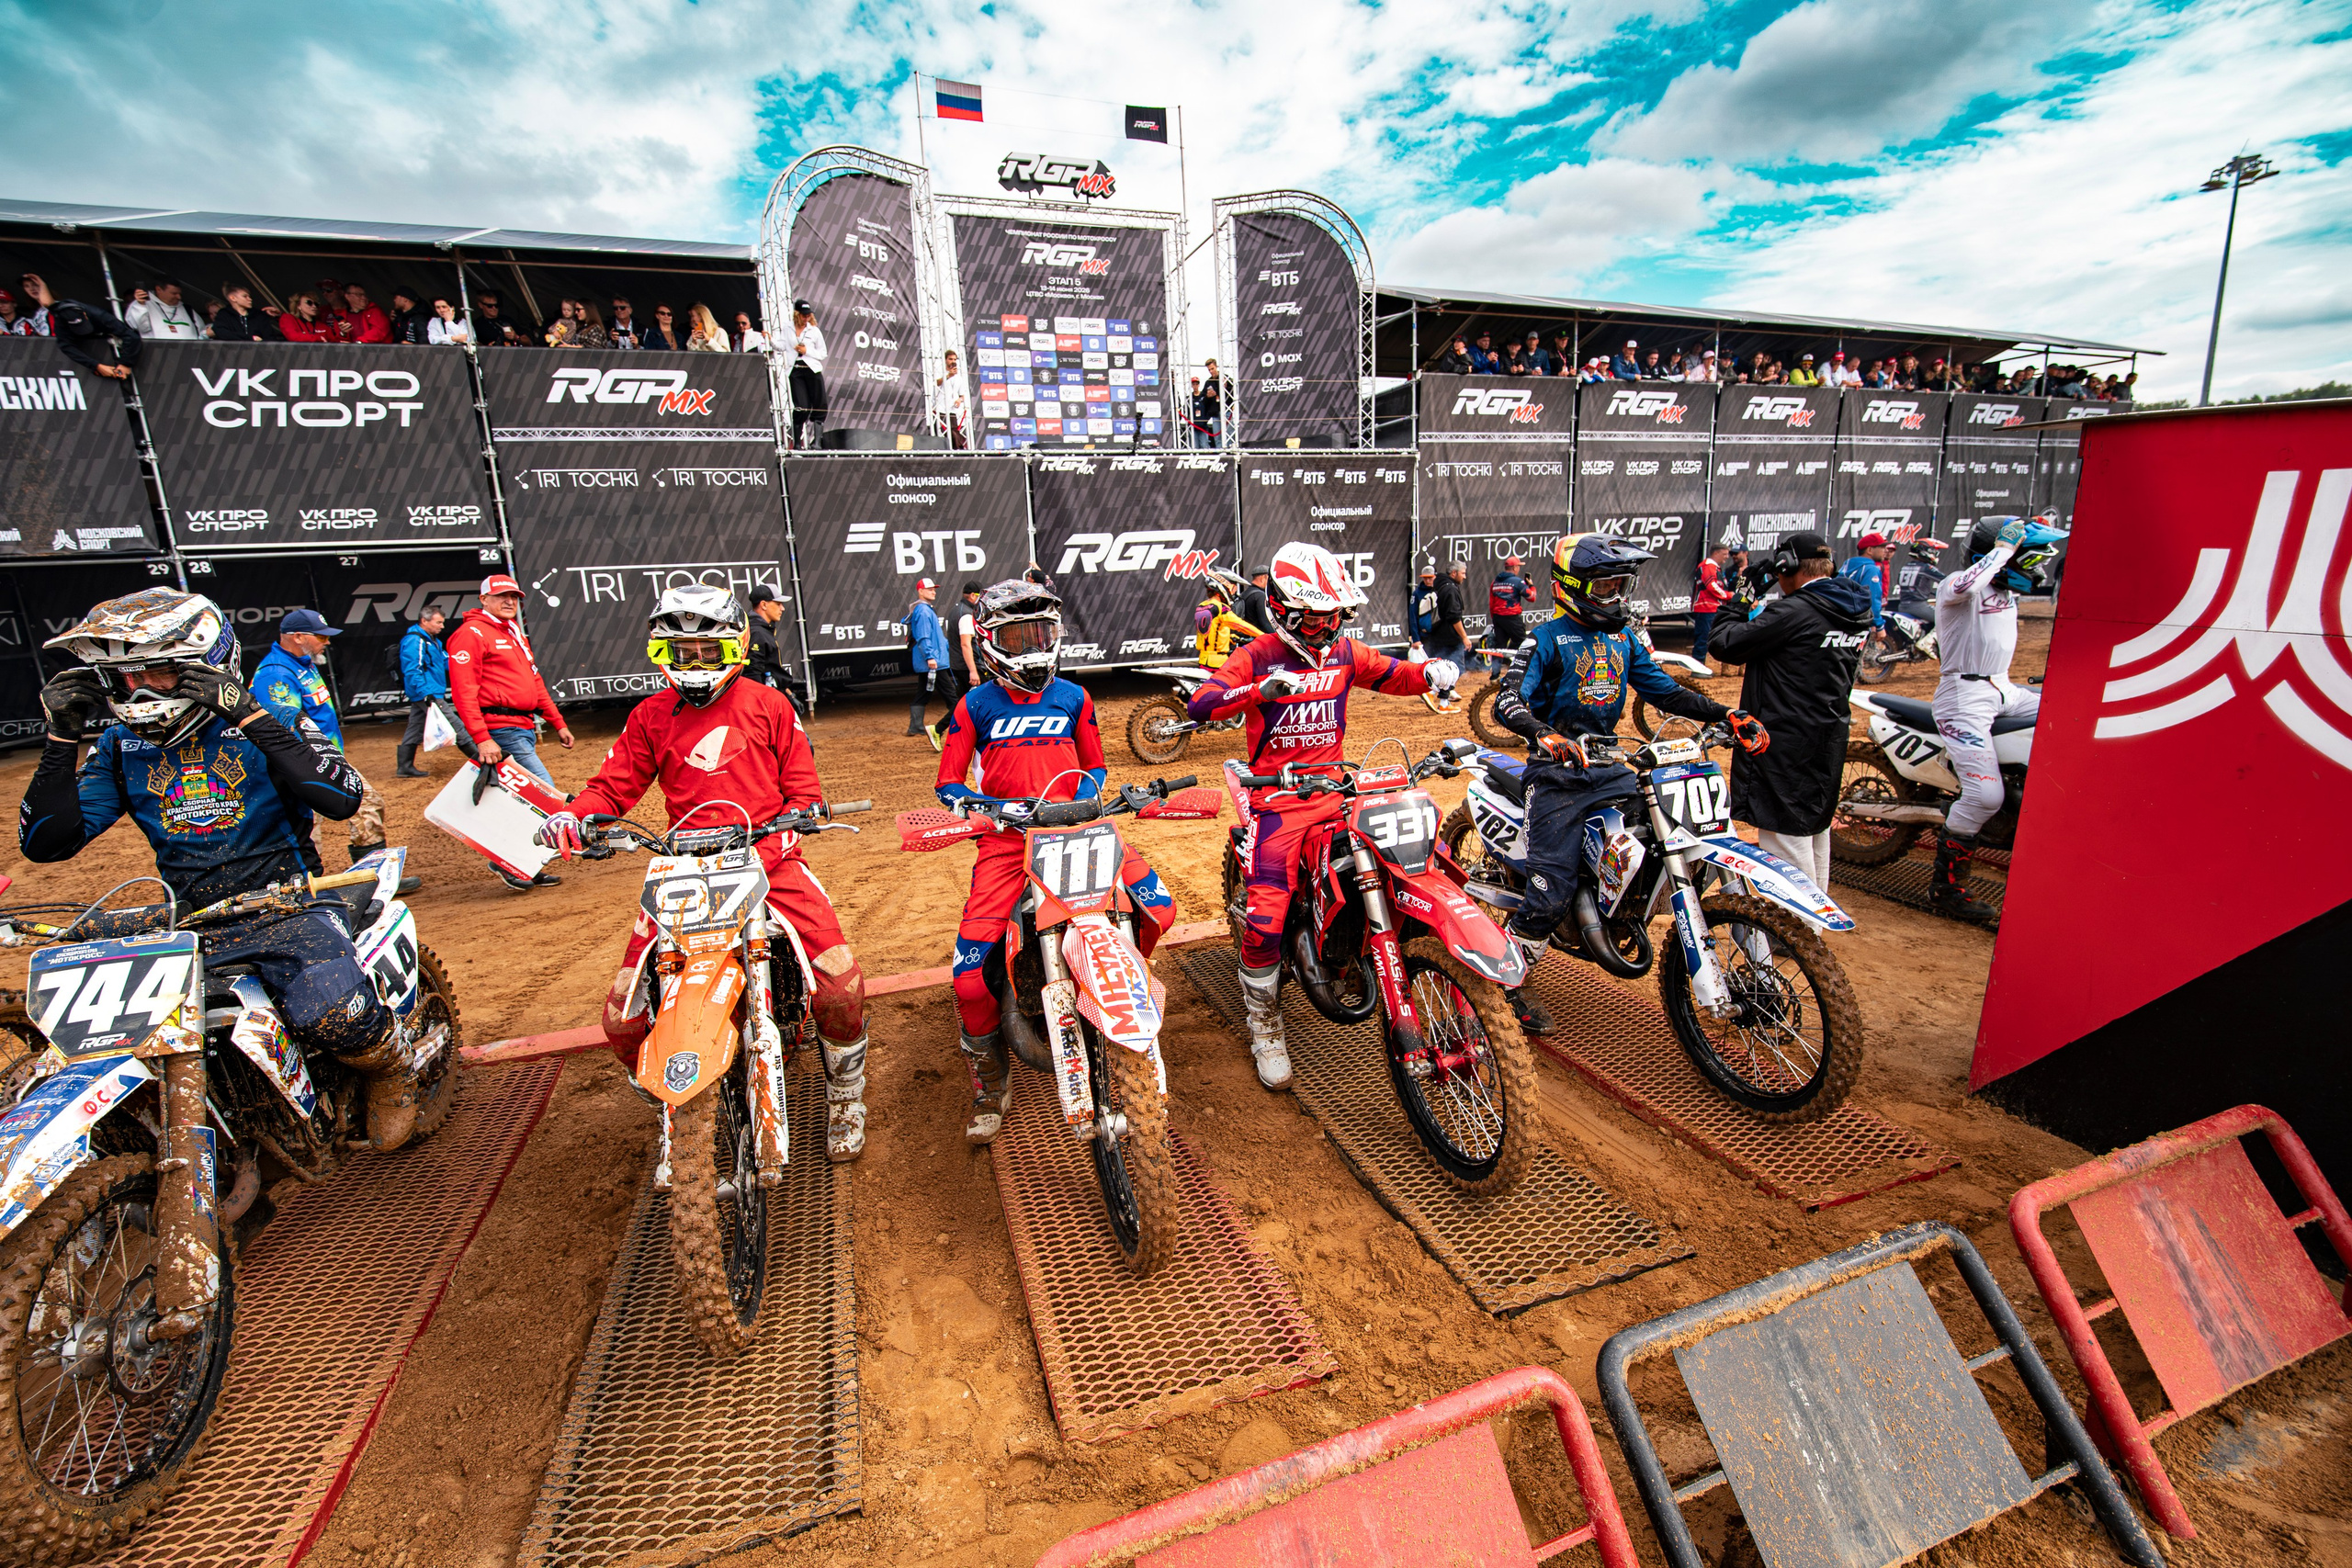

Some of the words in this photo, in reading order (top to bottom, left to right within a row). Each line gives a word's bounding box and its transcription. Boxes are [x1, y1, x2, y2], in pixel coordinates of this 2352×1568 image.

[859, 241, 888, 262] ВТБ
[1048, 276, 1073, 286] ЭТАП
[1075, 278, 1081, 287] 5
[1272, 270, 1299, 287] ВТБ
[858, 369, 900, 383] СПОРТ
[288, 369, 421, 398] ПРО
[1261, 384, 1303, 393] СПОРТ
[202, 400, 424, 428] СПОРТ
[1454, 464, 1492, 477] TOCHKI
[1527, 463, 1562, 476] TOCHKI
[1594, 460, 1614, 468] ПРО
[1639, 460, 1659, 468] ПРО
[1670, 467, 1702, 475] СПОРТ
[1951, 463, 1965, 474] ВТБ
[1973, 464, 1986, 474] ВТБ
[1995, 464, 2008, 474] ВТБ
[2016, 464, 2030, 474] ВТБ
[702, 470, 768, 486] TOCHKI
[1261, 471, 1284, 486] ВТБ
[1303, 471, 1326, 485] ВТБ
[1344, 470, 1367, 484] ВТБ
[1384, 469, 1407, 483] ВТБ
[1580, 468, 1614, 476] СПОРТ
[1625, 468, 1659, 476] СПОРТ
[568, 471, 639, 488] TOCHKI
[887, 473, 971, 488] Официальный
[888, 492, 937, 505] спонсор
[220, 508, 269, 521] ПРО
[330, 507, 378, 520] ПРО
[438, 504, 481, 516] ПРО
[1311, 505, 1373, 518] Официальный
[188, 520, 270, 533] СПОРТ
[300, 519, 379, 531] СПОРТ
[410, 514, 481, 528] СПОРТ
[1310, 520, 1346, 533] спонсор
[1628, 516, 1683, 535] ПРО
[1748, 508, 1815, 533] МОСКОВСКИЙ
[75, 525, 144, 539] МОСКОВСКИЙ
[80, 538, 111, 550] СПОРТ
[1747, 532, 1781, 551] СПОРТ
[480, 549, 500, 561] 26
[892, 529, 987, 575] ВТБ
[188, 560, 212, 574] 28
[339, 556, 359, 567] 27
[147, 563, 170, 576] 29
[1661, 603, 1691, 611] СПОРТ
[835, 624, 866, 640] ВТБ
[1380, 624, 1402, 637] ВТБ
[989, 716, 1069, 739] UFO
[1270, 719, 1338, 735] MOTORSPORTS
[1299, 732, 1337, 748] TOCHKI
[1881, 724, 1943, 768] 707
[498, 764, 530, 793] 52
[182, 797, 217, 806] СБОРНАЯ
[220, 800, 241, 808] КРАЯ
[1660, 775, 1731, 825] 702
[173, 807, 234, 823] МОТОКРОСС
[674, 826, 734, 840] WRP
[922, 825, 973, 839] ACERBIS
[1368, 806, 1437, 850] 331
[1475, 804, 1520, 852] 702
[678, 834, 729, 845] wrpracing.com
[650, 863, 674, 874] KTM
[1035, 833, 1116, 897] 111
[655, 871, 761, 928] 97
[37, 953, 195, 1041] 744
